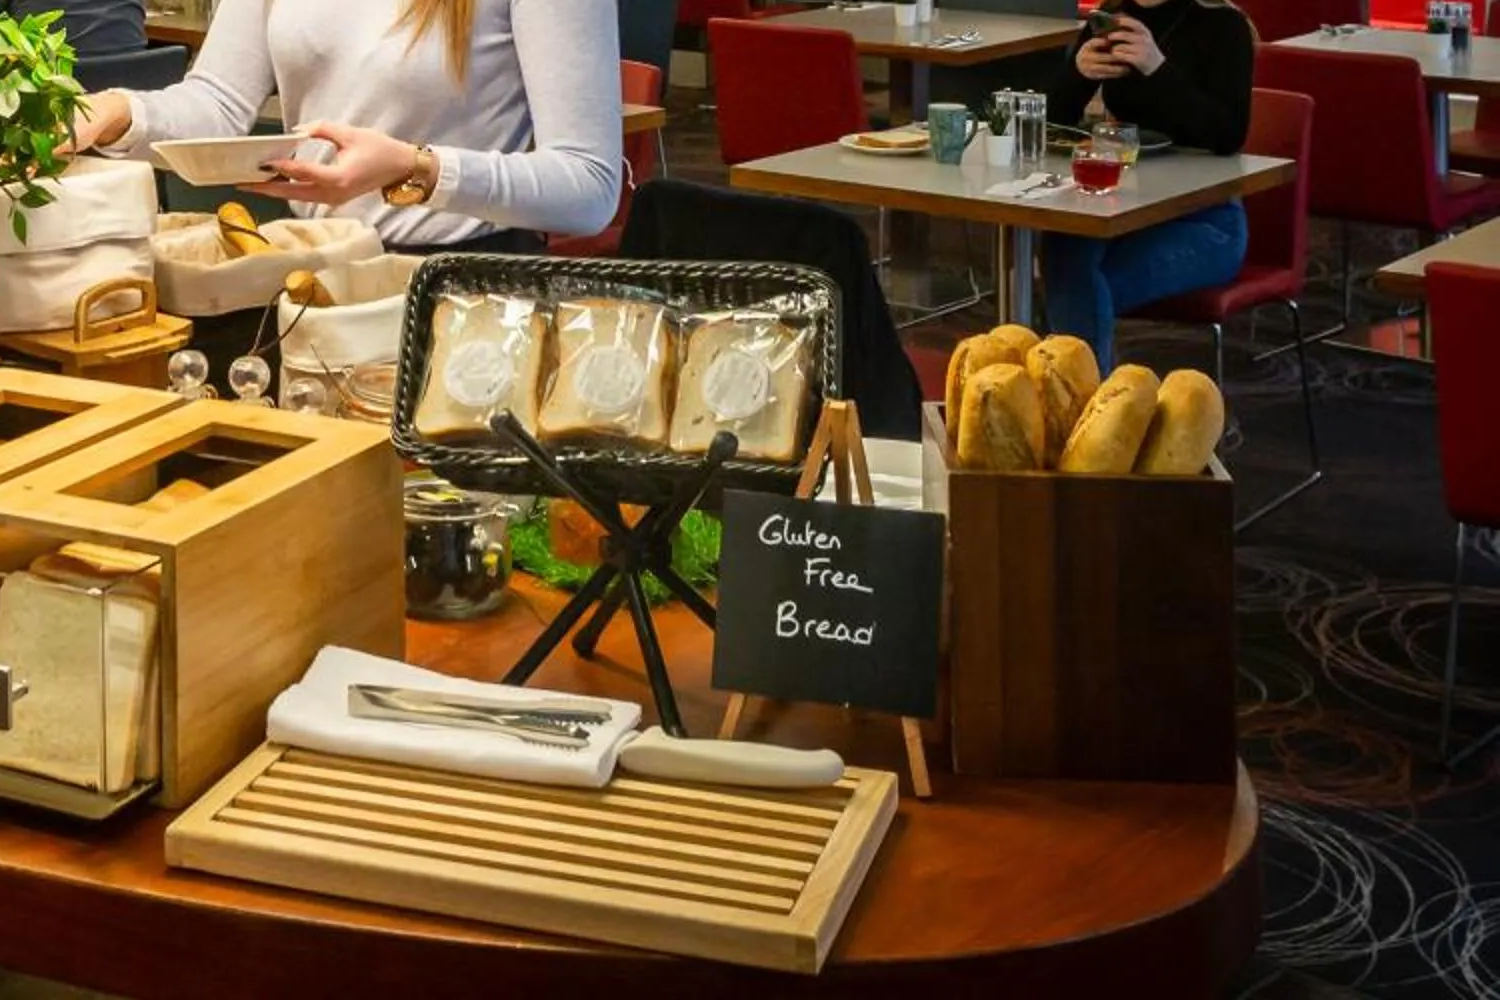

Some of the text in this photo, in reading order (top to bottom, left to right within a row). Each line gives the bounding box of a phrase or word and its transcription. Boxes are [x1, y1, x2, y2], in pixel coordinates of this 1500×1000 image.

[758, 514, 841, 550] Gluten
[803, 557, 874, 593] Free
[775, 600, 876, 645] Bread
